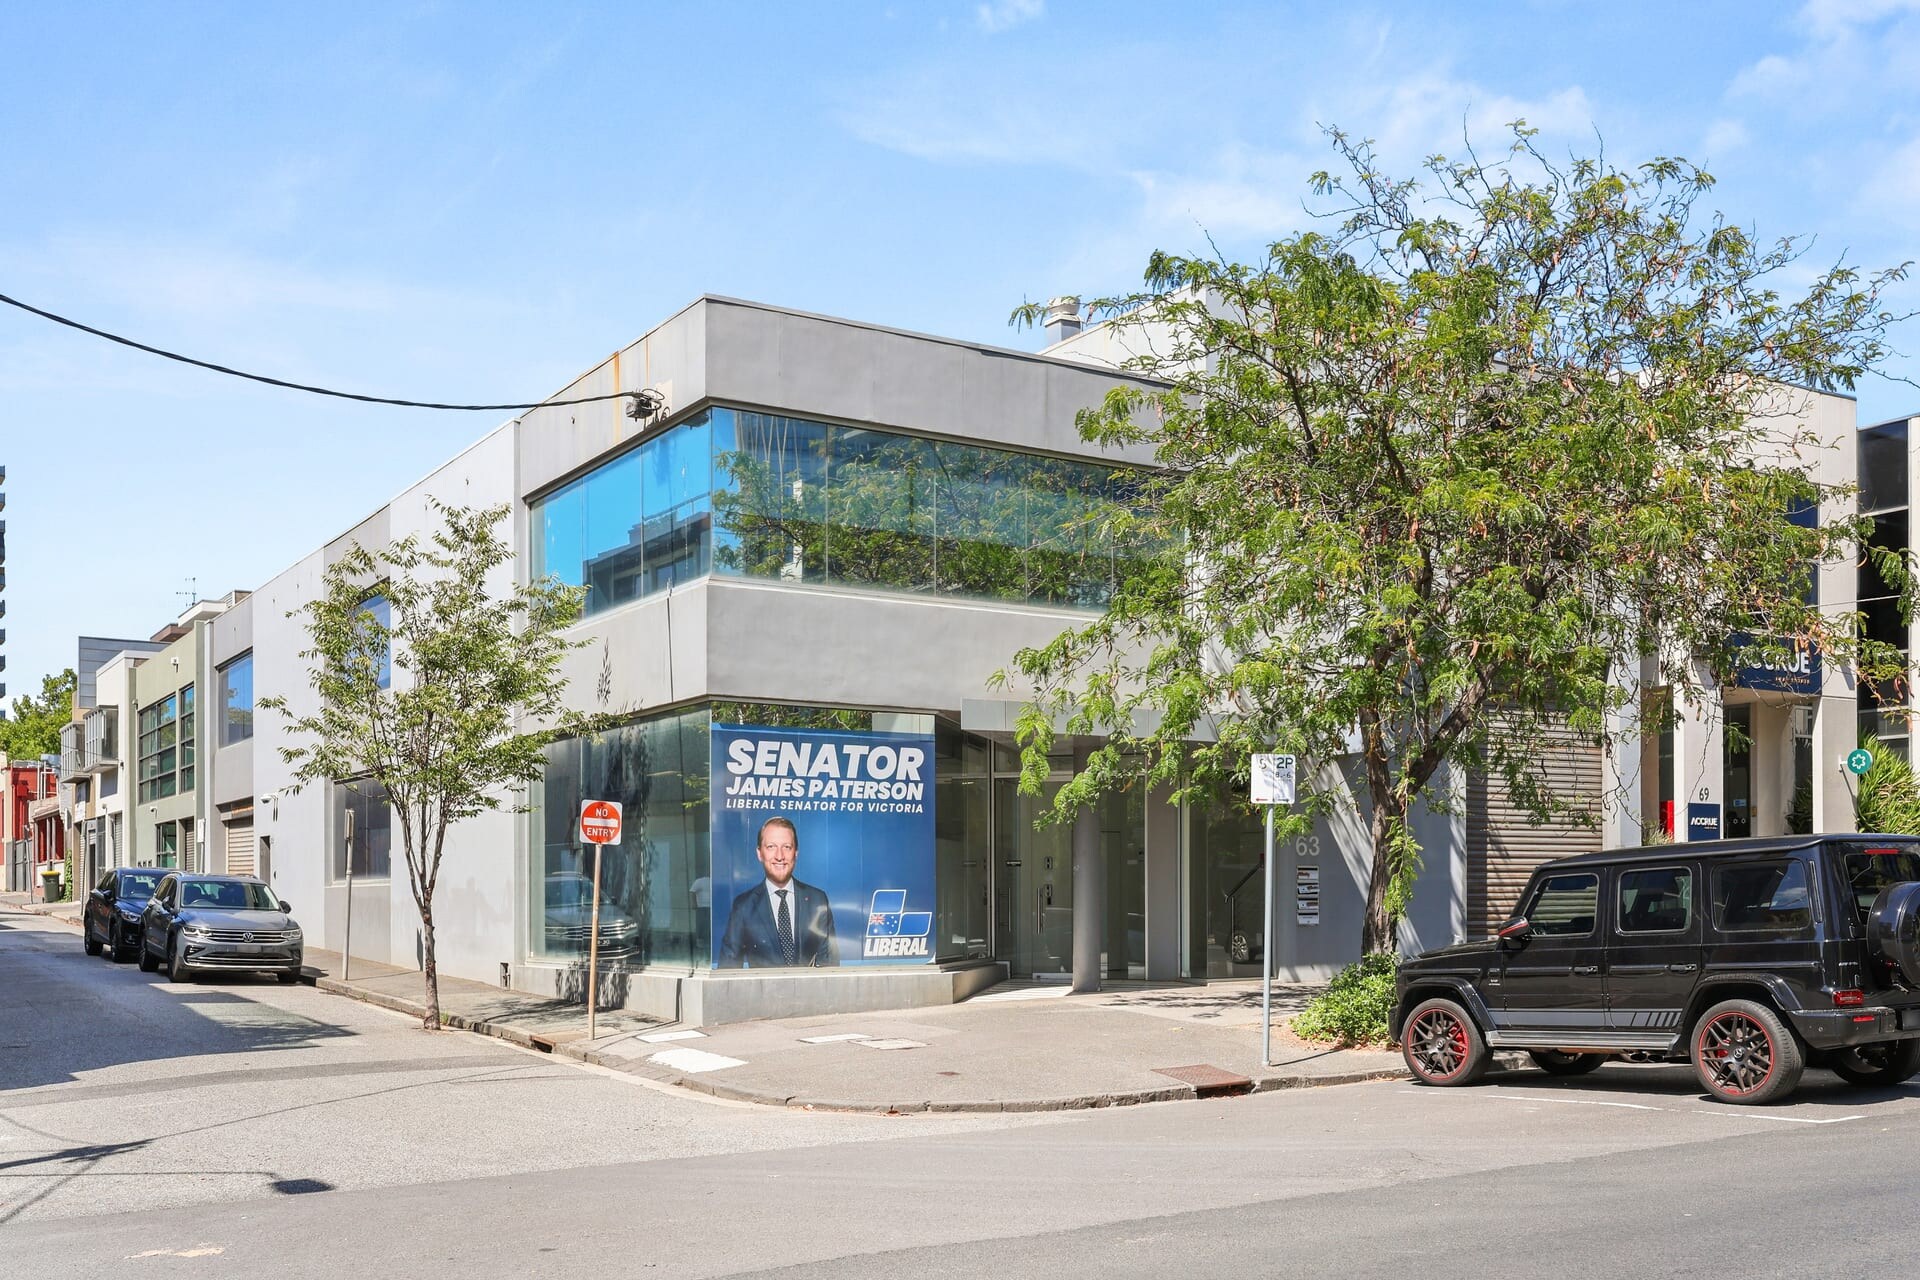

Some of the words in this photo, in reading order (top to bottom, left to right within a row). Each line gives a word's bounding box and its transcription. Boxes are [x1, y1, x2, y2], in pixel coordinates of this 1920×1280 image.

[726, 738, 925, 781] SENATOR
[1276, 757, 1294, 769] 2P
[726, 776, 806, 798] JAMES
[808, 779, 924, 801] PATERSON
[1699, 787, 1710, 801] 69
[595, 808, 608, 816] NO
[726, 798, 776, 810] LIBERAL
[780, 800, 837, 812] SENATOR
[840, 802, 864, 812] FOR
[868, 803, 923, 814] VICTORIA
[586, 827, 615, 837] ENTRY
[1296, 836, 1320, 856] 63
[863, 937, 929, 957] LIBERAL
